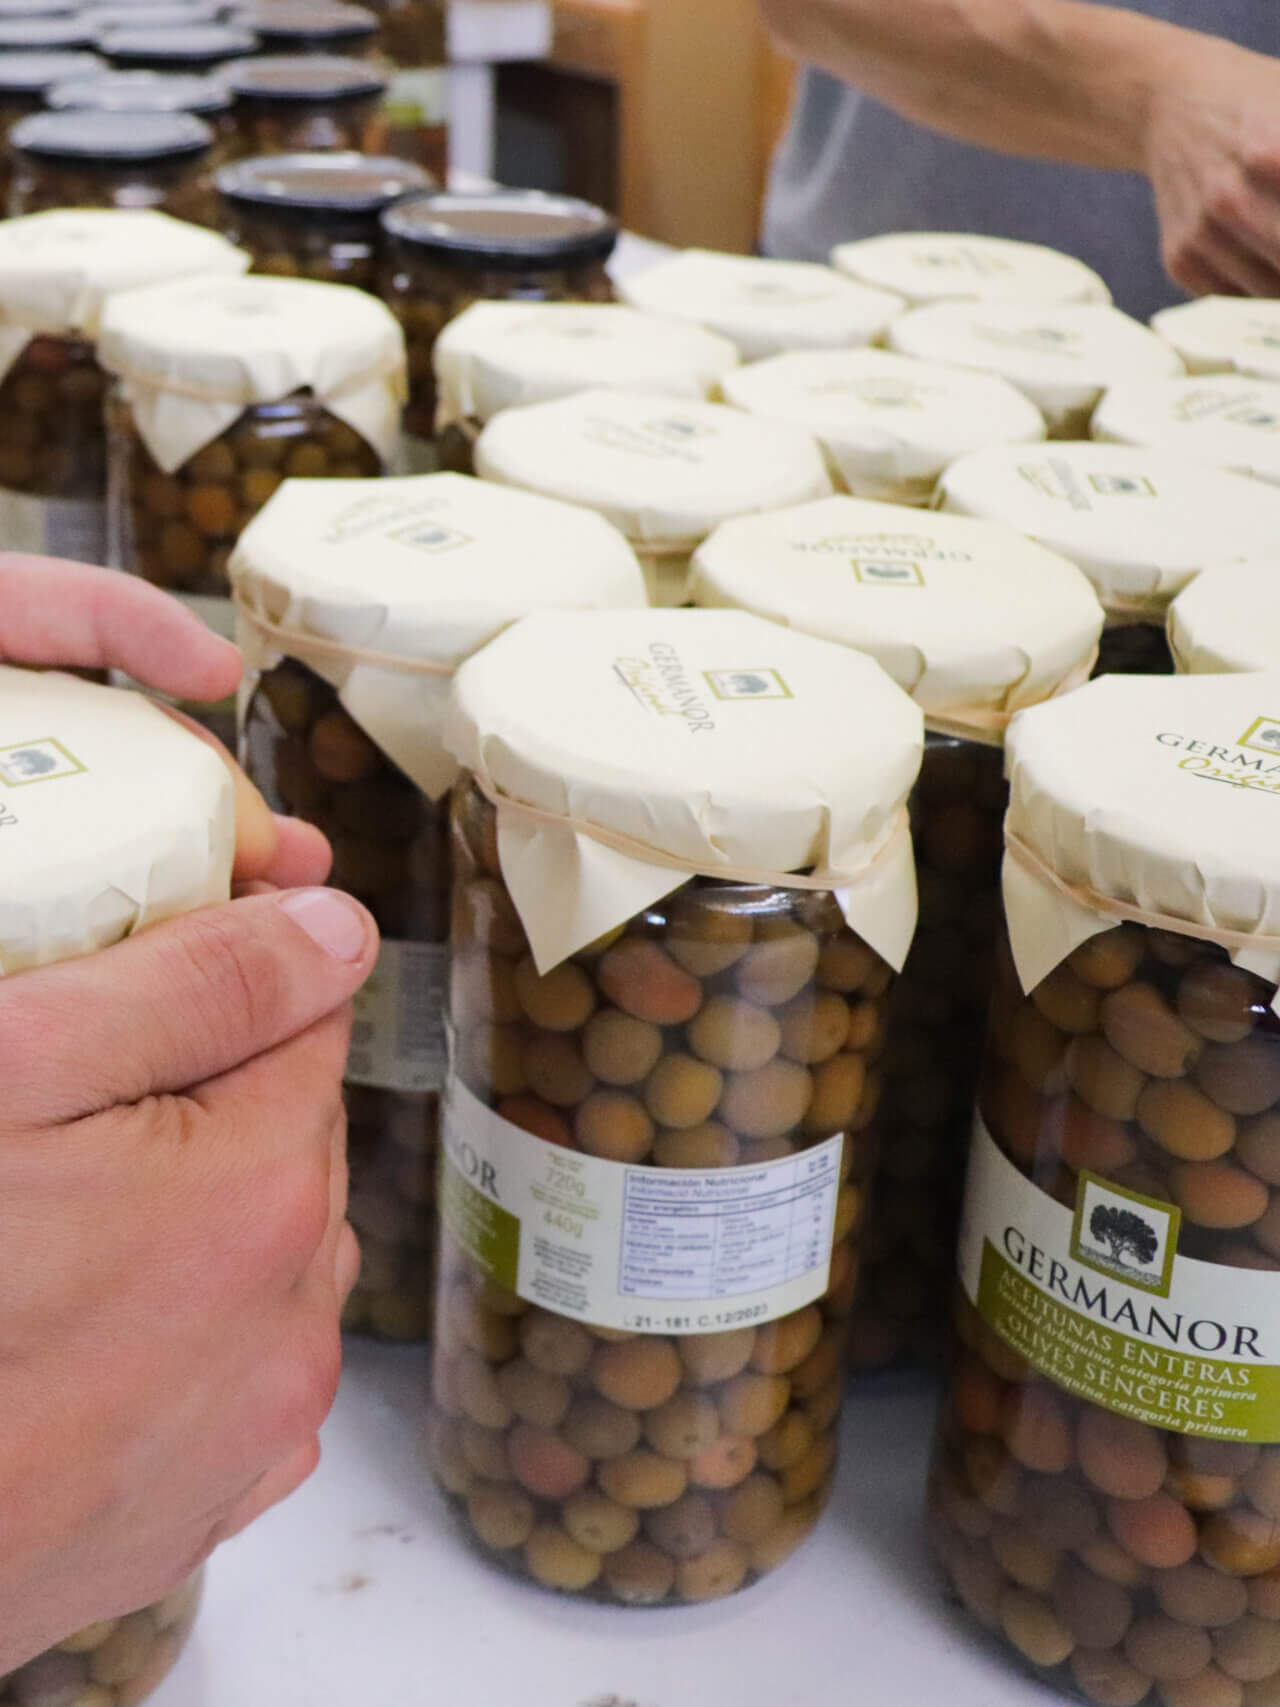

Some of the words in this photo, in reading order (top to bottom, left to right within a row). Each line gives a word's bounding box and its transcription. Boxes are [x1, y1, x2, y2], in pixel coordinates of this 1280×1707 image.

[648, 641, 716, 734] GERMANOR
[999, 1269, 1113, 1350] ACEITUNAS
[1122, 1341, 1251, 1386] ENTERAS
[1004, 1226, 1265, 1358] GERMANOR
[1008, 1314, 1076, 1371] OLIVES
[1086, 1361, 1225, 1420] SENCERES
[1192, 1383, 1257, 1401] primera
[1183, 1419, 1249, 1438] primera
